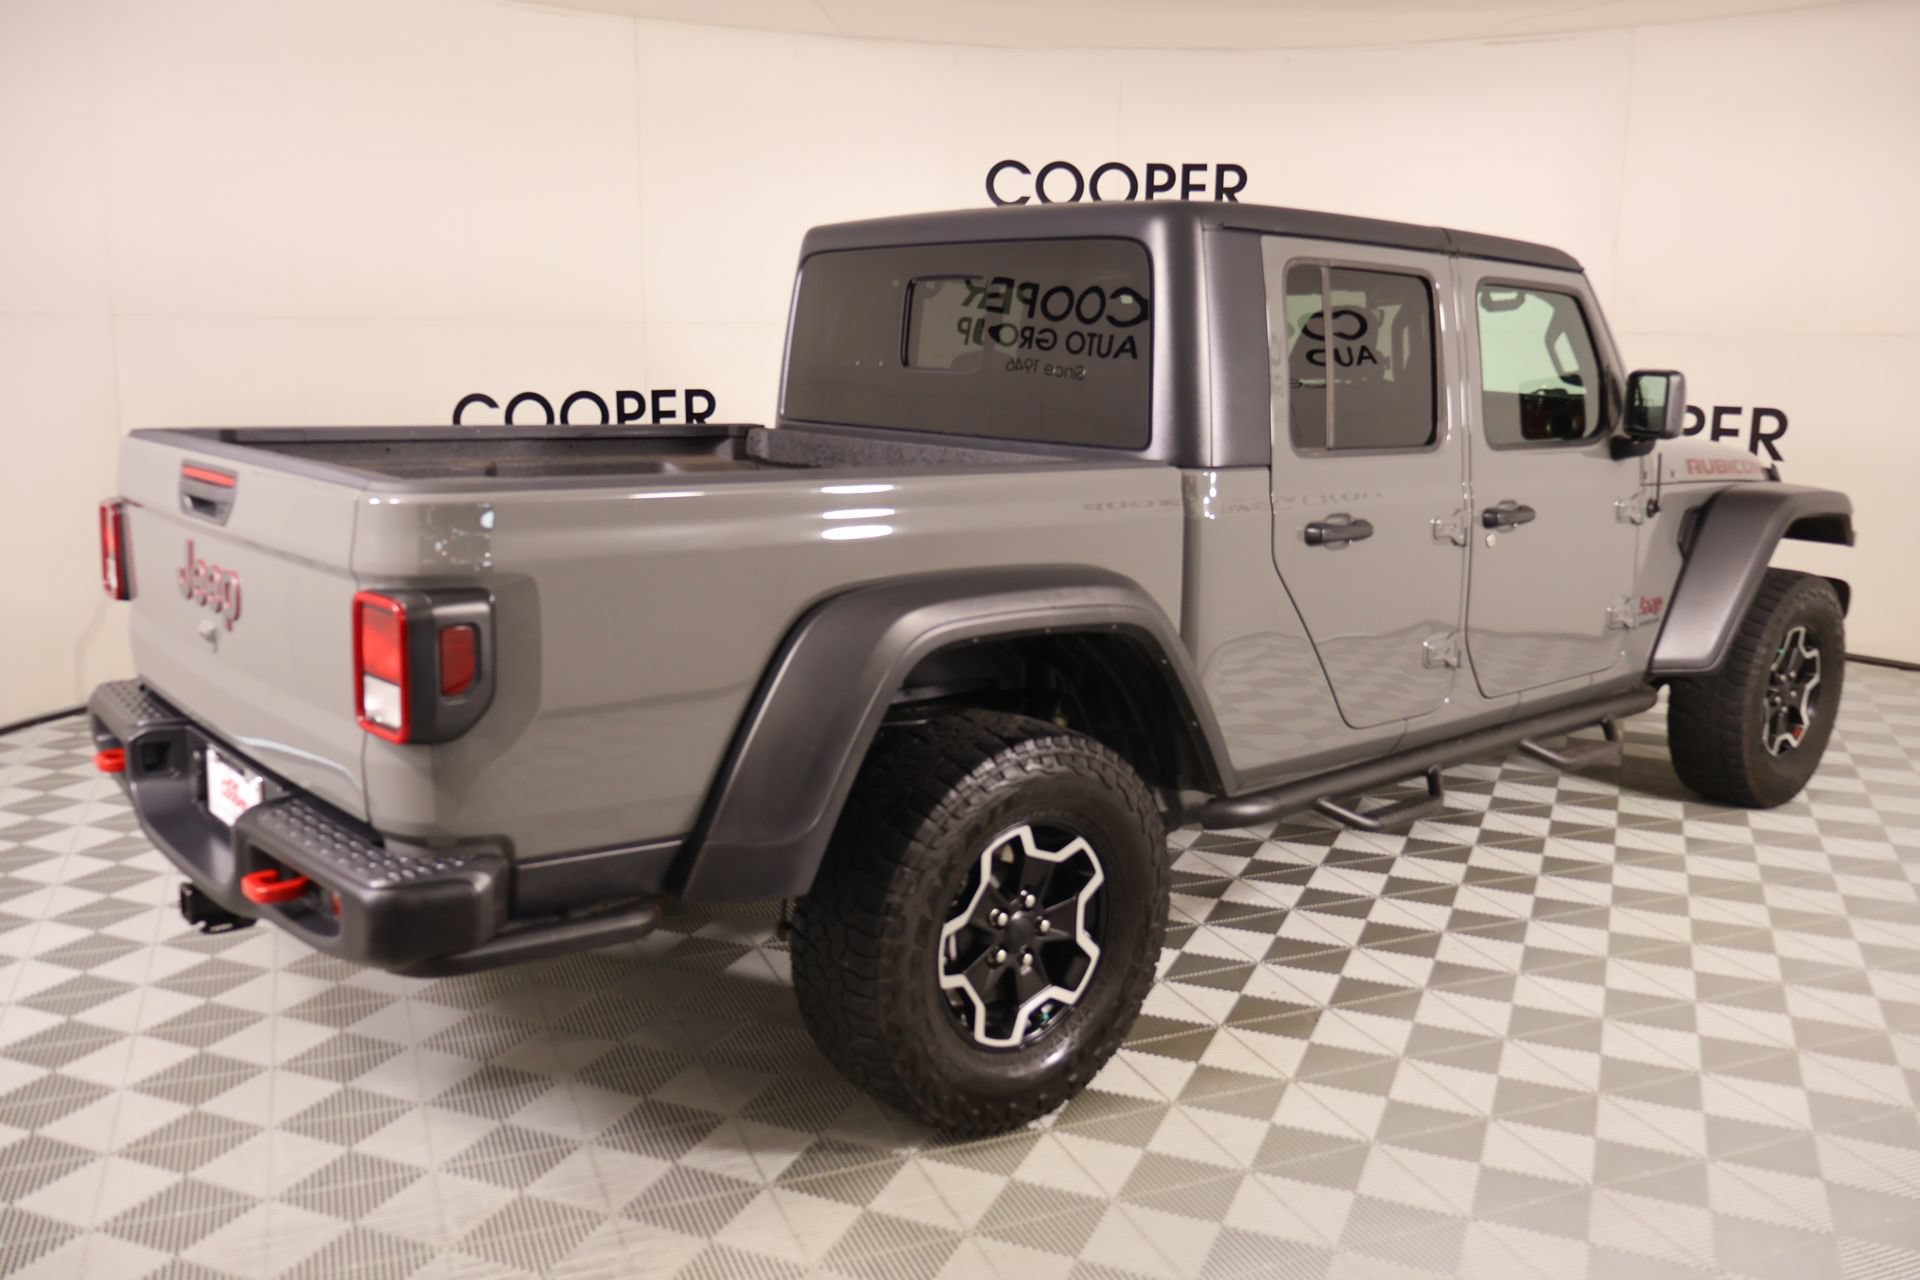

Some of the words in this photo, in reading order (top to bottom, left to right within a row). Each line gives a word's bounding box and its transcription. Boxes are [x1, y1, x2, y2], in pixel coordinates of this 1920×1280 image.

[986, 159, 1248, 206] COOPER
[453, 389, 716, 425] COOPER
[178, 538, 241, 632] Jeep
